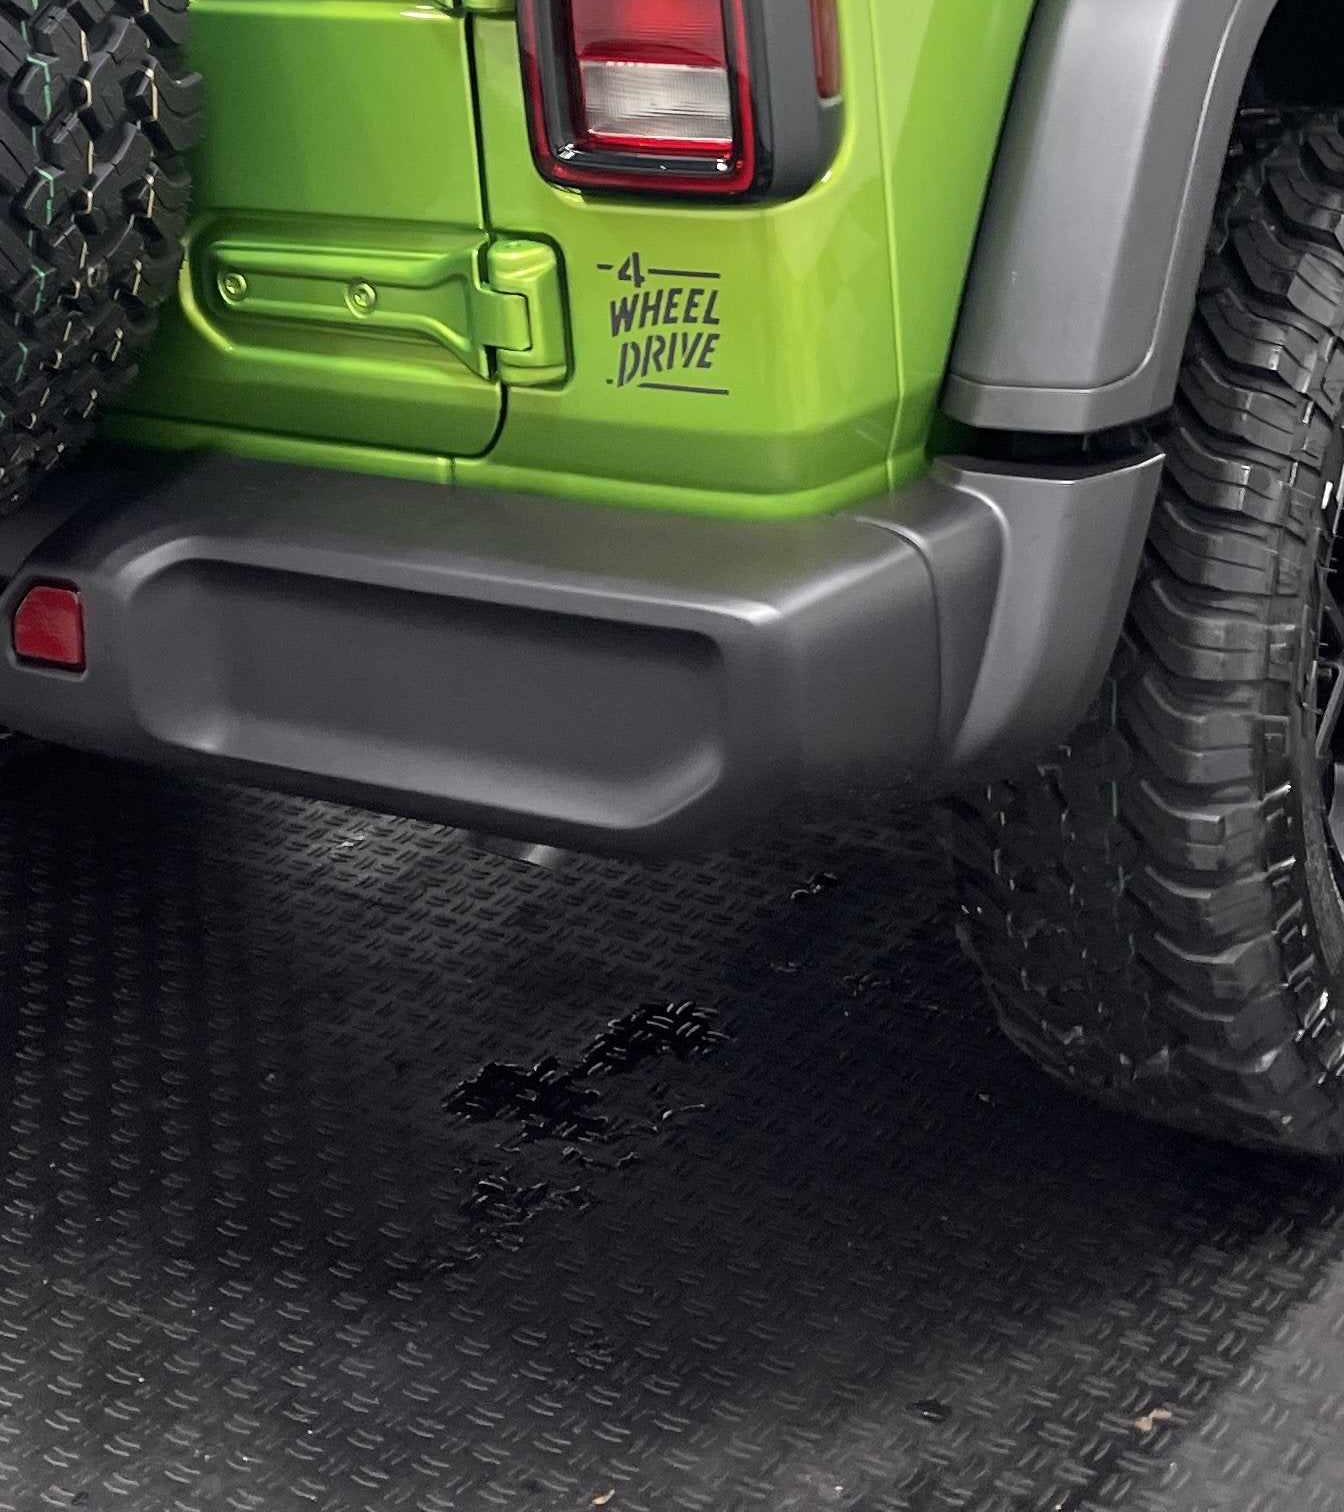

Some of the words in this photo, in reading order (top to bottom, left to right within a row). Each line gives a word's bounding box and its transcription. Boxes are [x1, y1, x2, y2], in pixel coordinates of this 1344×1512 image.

[617, 252, 645, 288] 4
[610, 288, 720, 337] WHEEL
[617, 332, 721, 388] DRIVE
